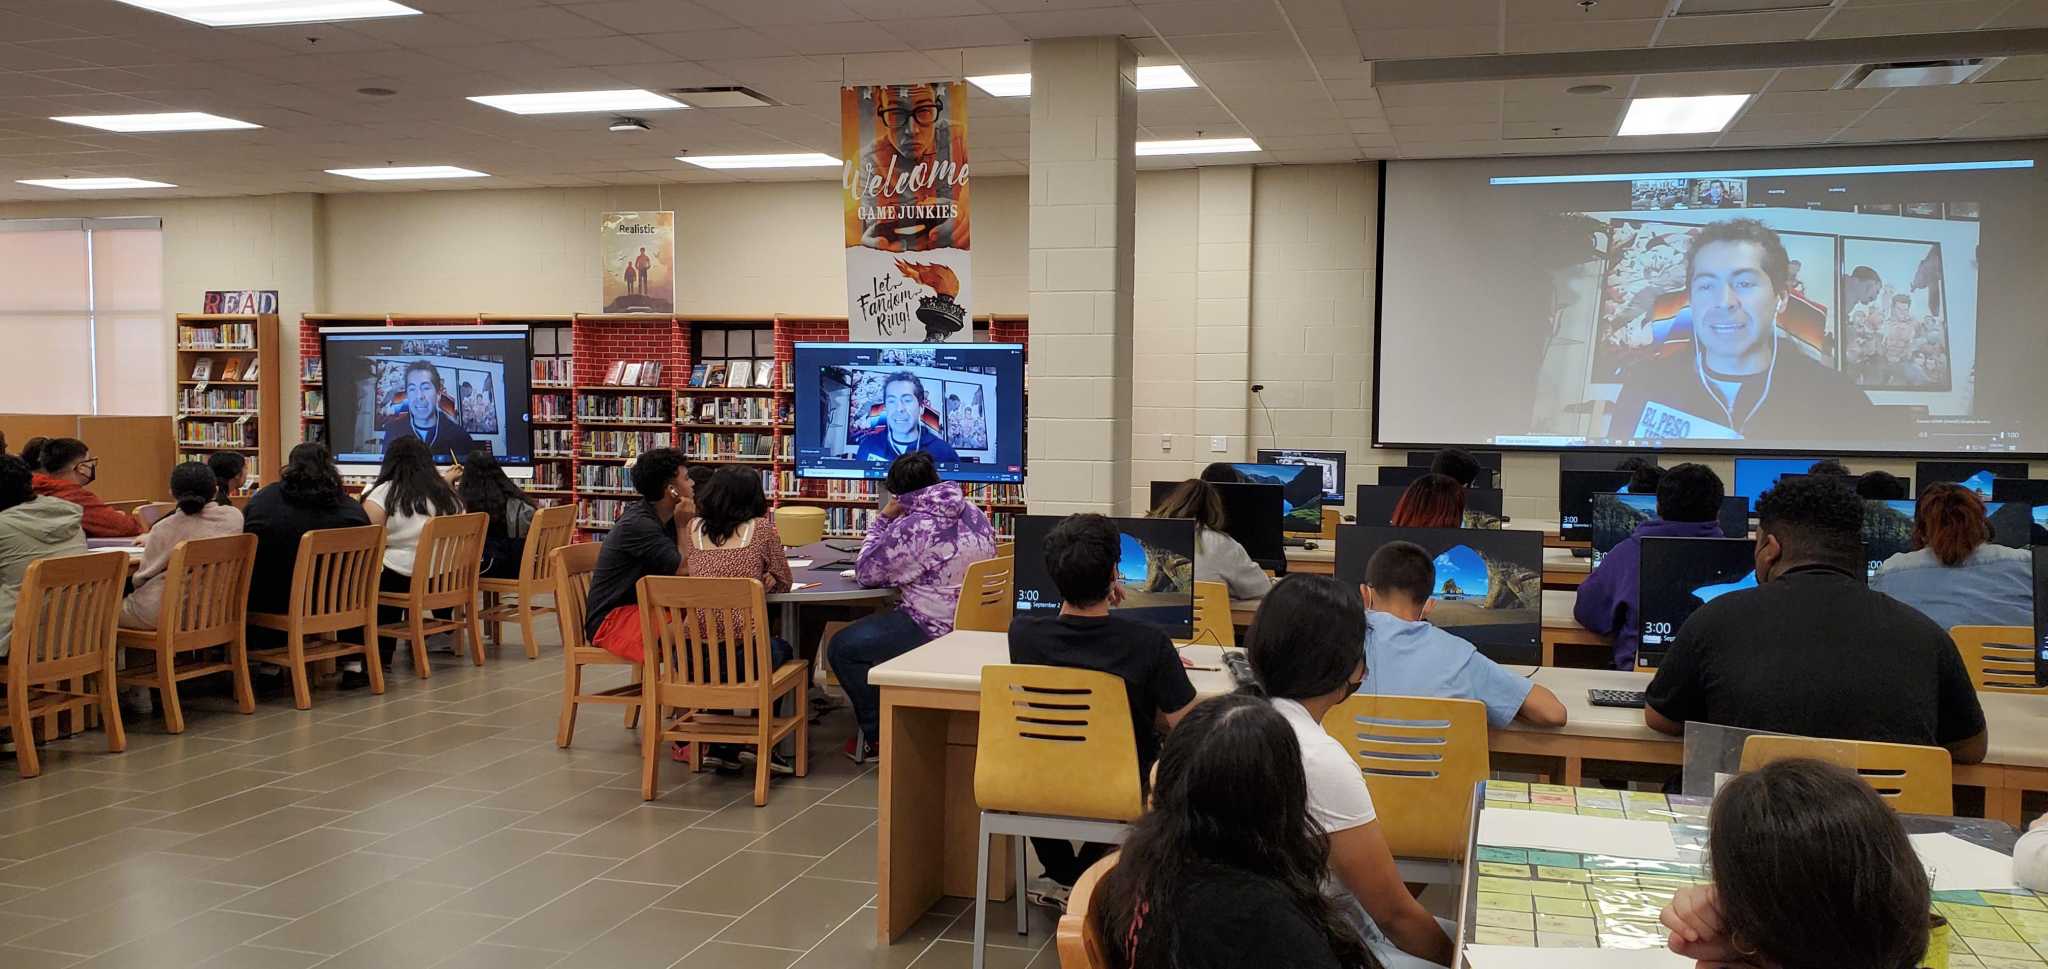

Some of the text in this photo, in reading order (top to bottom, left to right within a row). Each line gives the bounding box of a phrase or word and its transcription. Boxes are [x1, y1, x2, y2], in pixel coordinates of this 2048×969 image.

[842, 154, 969, 200] Welcome
[857, 203, 958, 220] GAME JUNKIES
[619, 223, 656, 234] Realistic
[872, 273, 903, 297] Let
[205, 289, 277, 314] READ
[857, 288, 923, 321] Fandom
[876, 302, 911, 336] Ring!
[1563, 515, 1578, 523] 3:00
[1018, 589, 1039, 601] 3:00
[1032, 601, 1057, 609] September
[1645, 621, 1671, 634] 3:00
